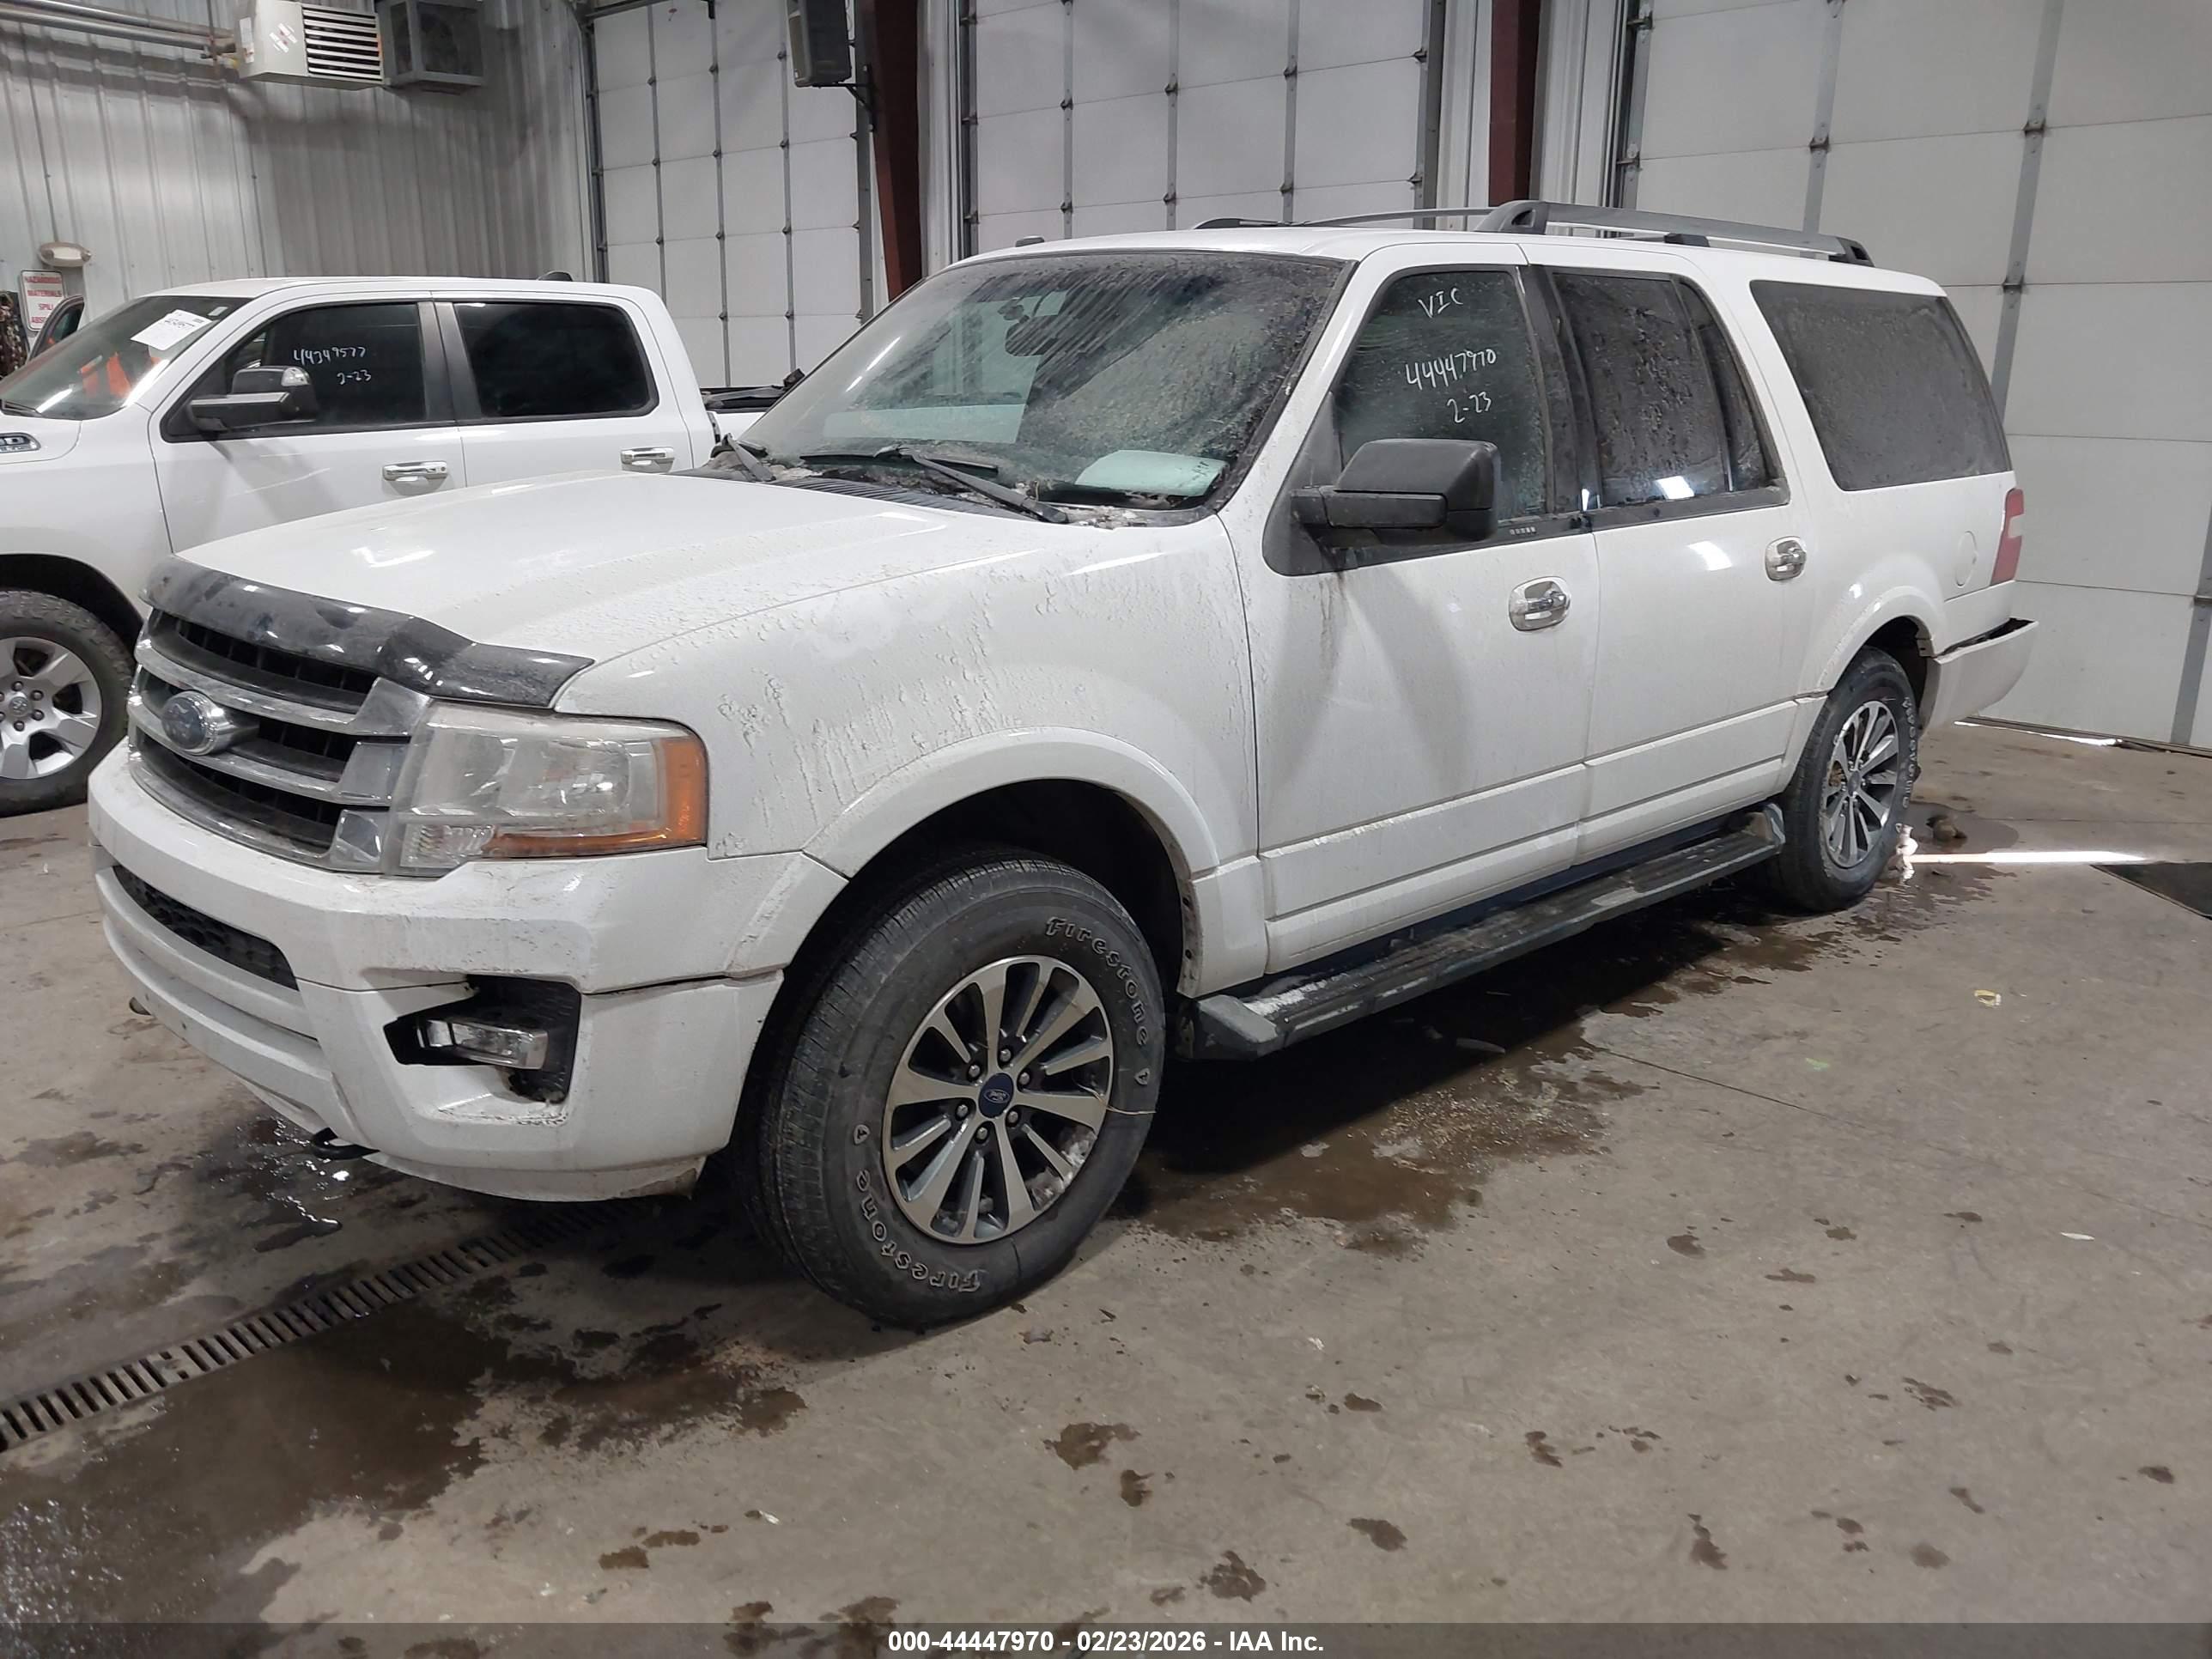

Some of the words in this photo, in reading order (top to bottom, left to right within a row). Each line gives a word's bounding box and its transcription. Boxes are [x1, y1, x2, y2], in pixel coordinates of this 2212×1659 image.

[1418, 288, 1463, 319] VIC
[1405, 349, 1497, 391] 44447970
[1447, 391, 1492, 423] 2-23
[1046, 916, 1148, 1046] Firestone
[856, 1170, 981, 1292] Firestone
